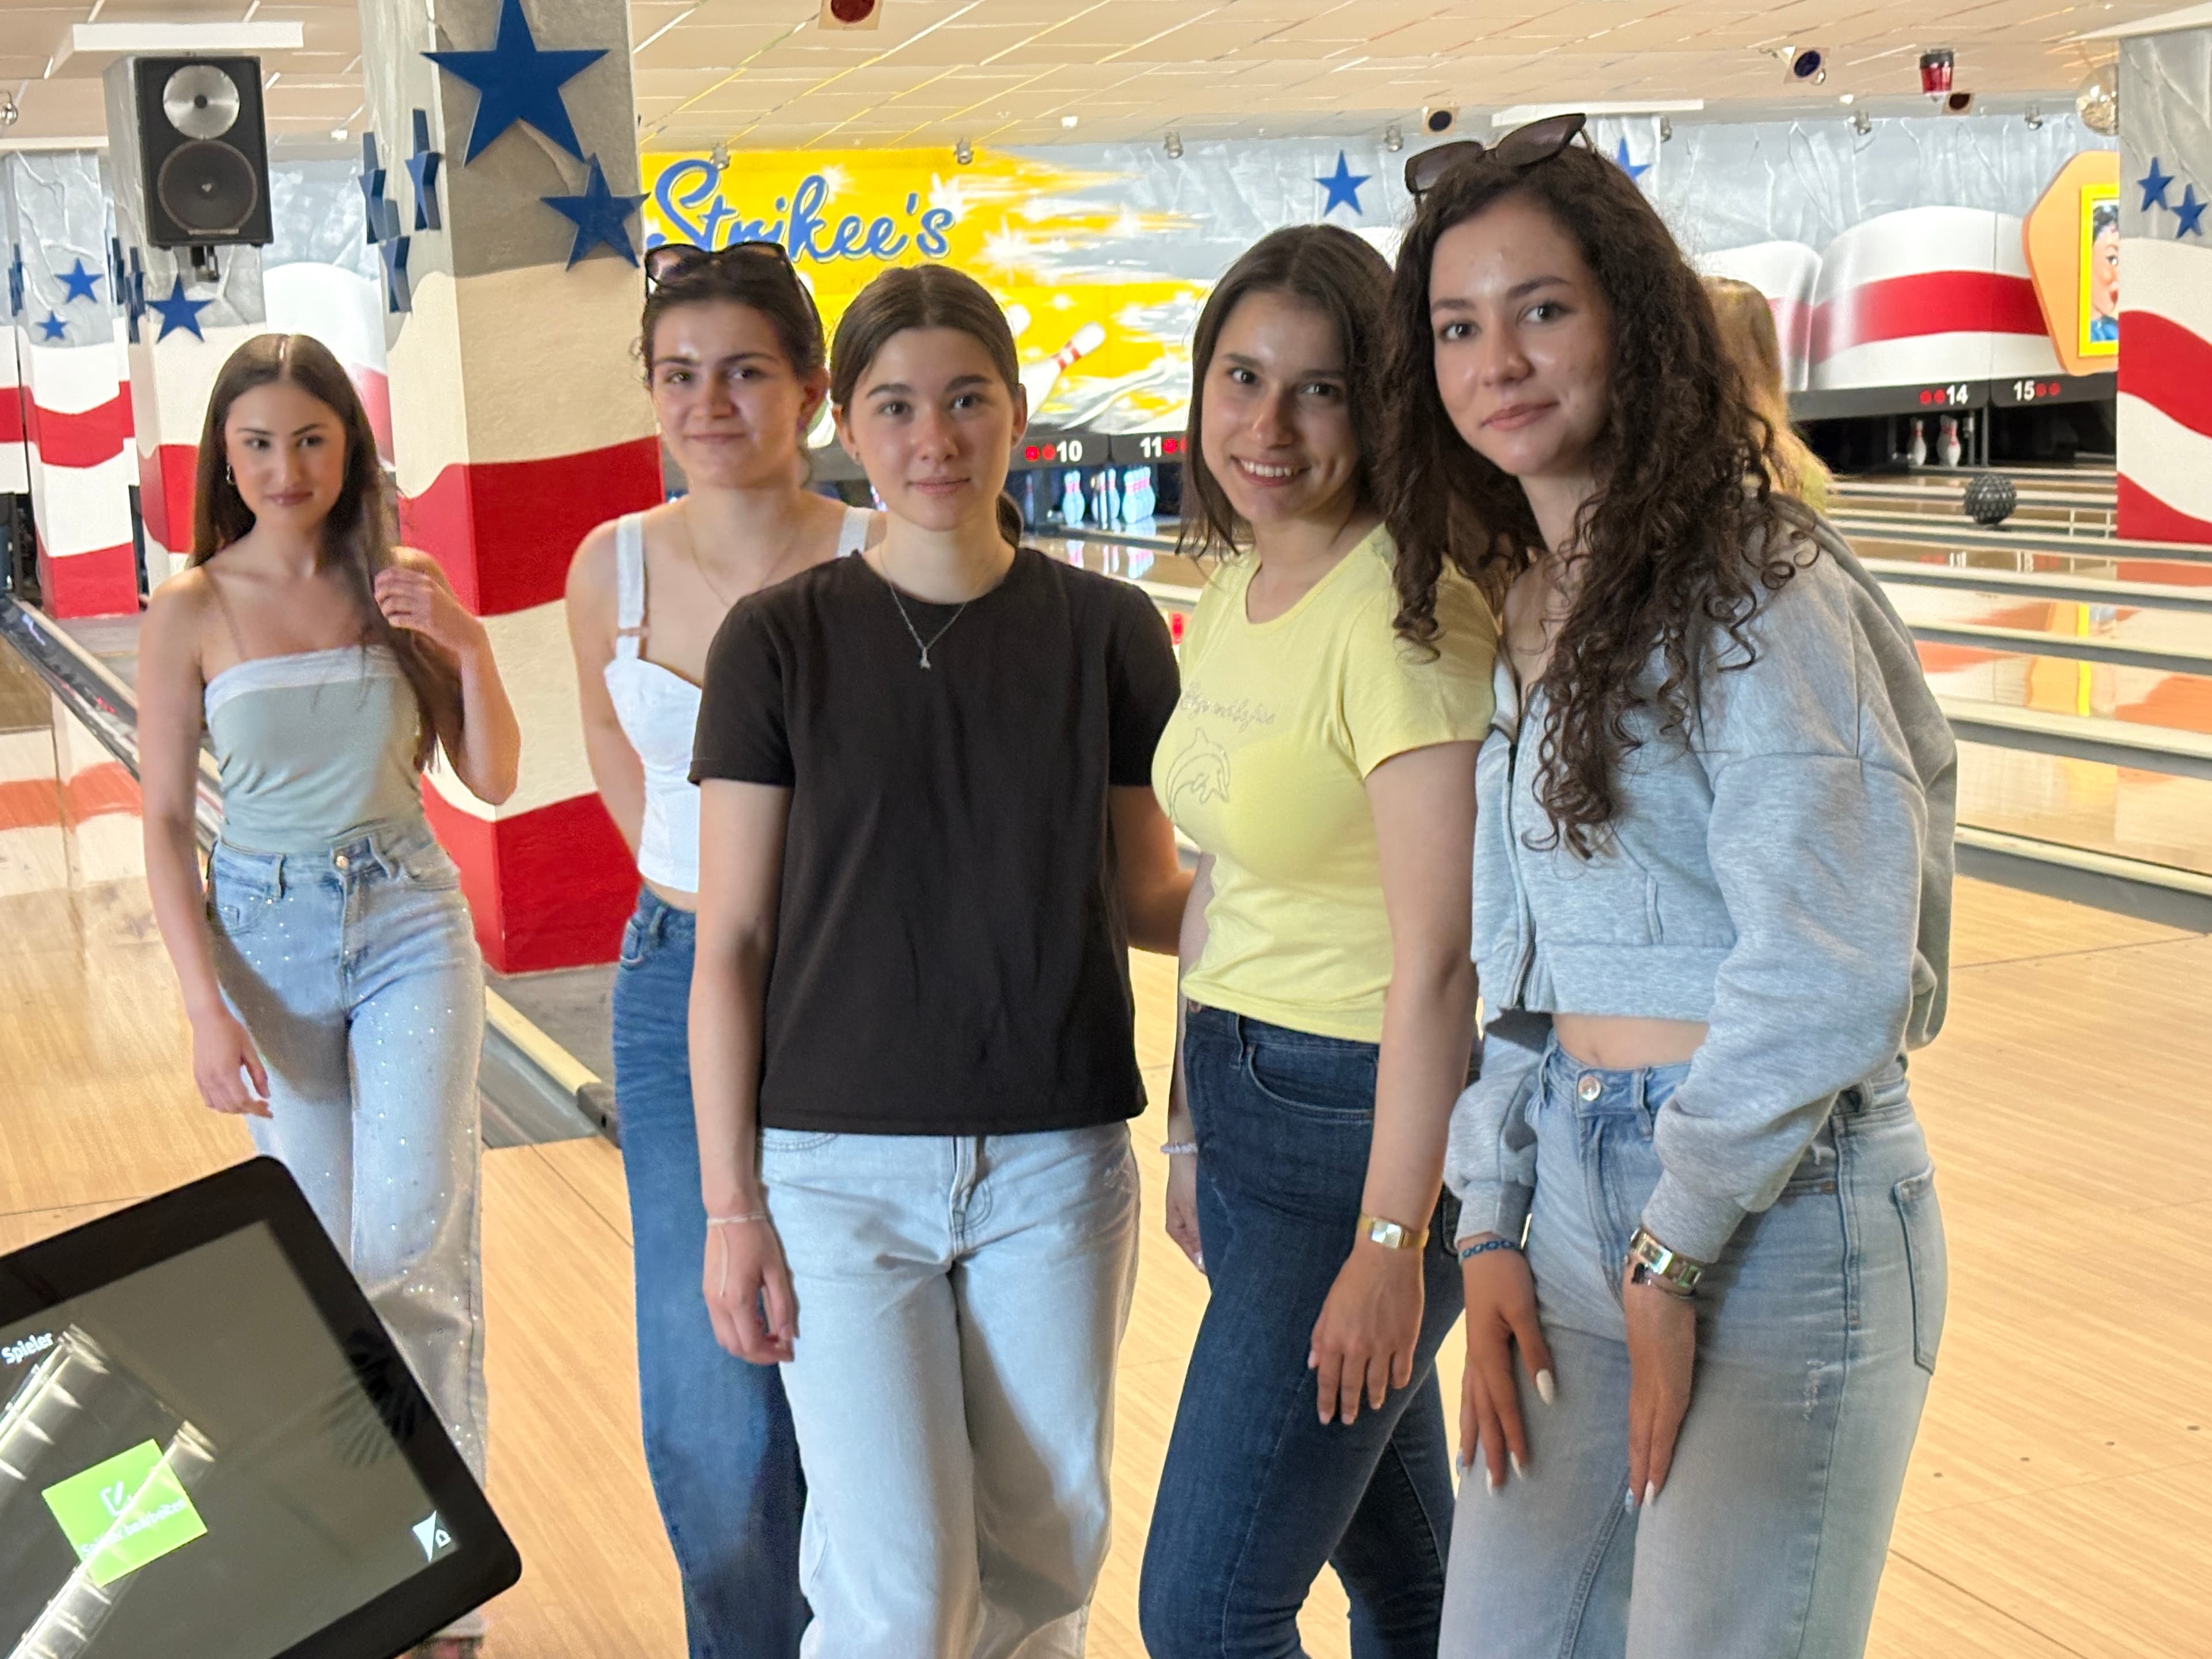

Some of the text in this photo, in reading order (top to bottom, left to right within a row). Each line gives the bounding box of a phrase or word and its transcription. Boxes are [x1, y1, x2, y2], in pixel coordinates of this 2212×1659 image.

[647, 159, 956, 263] Strikee's
[1946, 384, 1969, 406] 14
[2013, 380, 2036, 402] 15
[1056, 440, 1083, 463] 10
[1139, 436, 1162, 459] 11
[1, 1332, 54, 1365] Spieler
